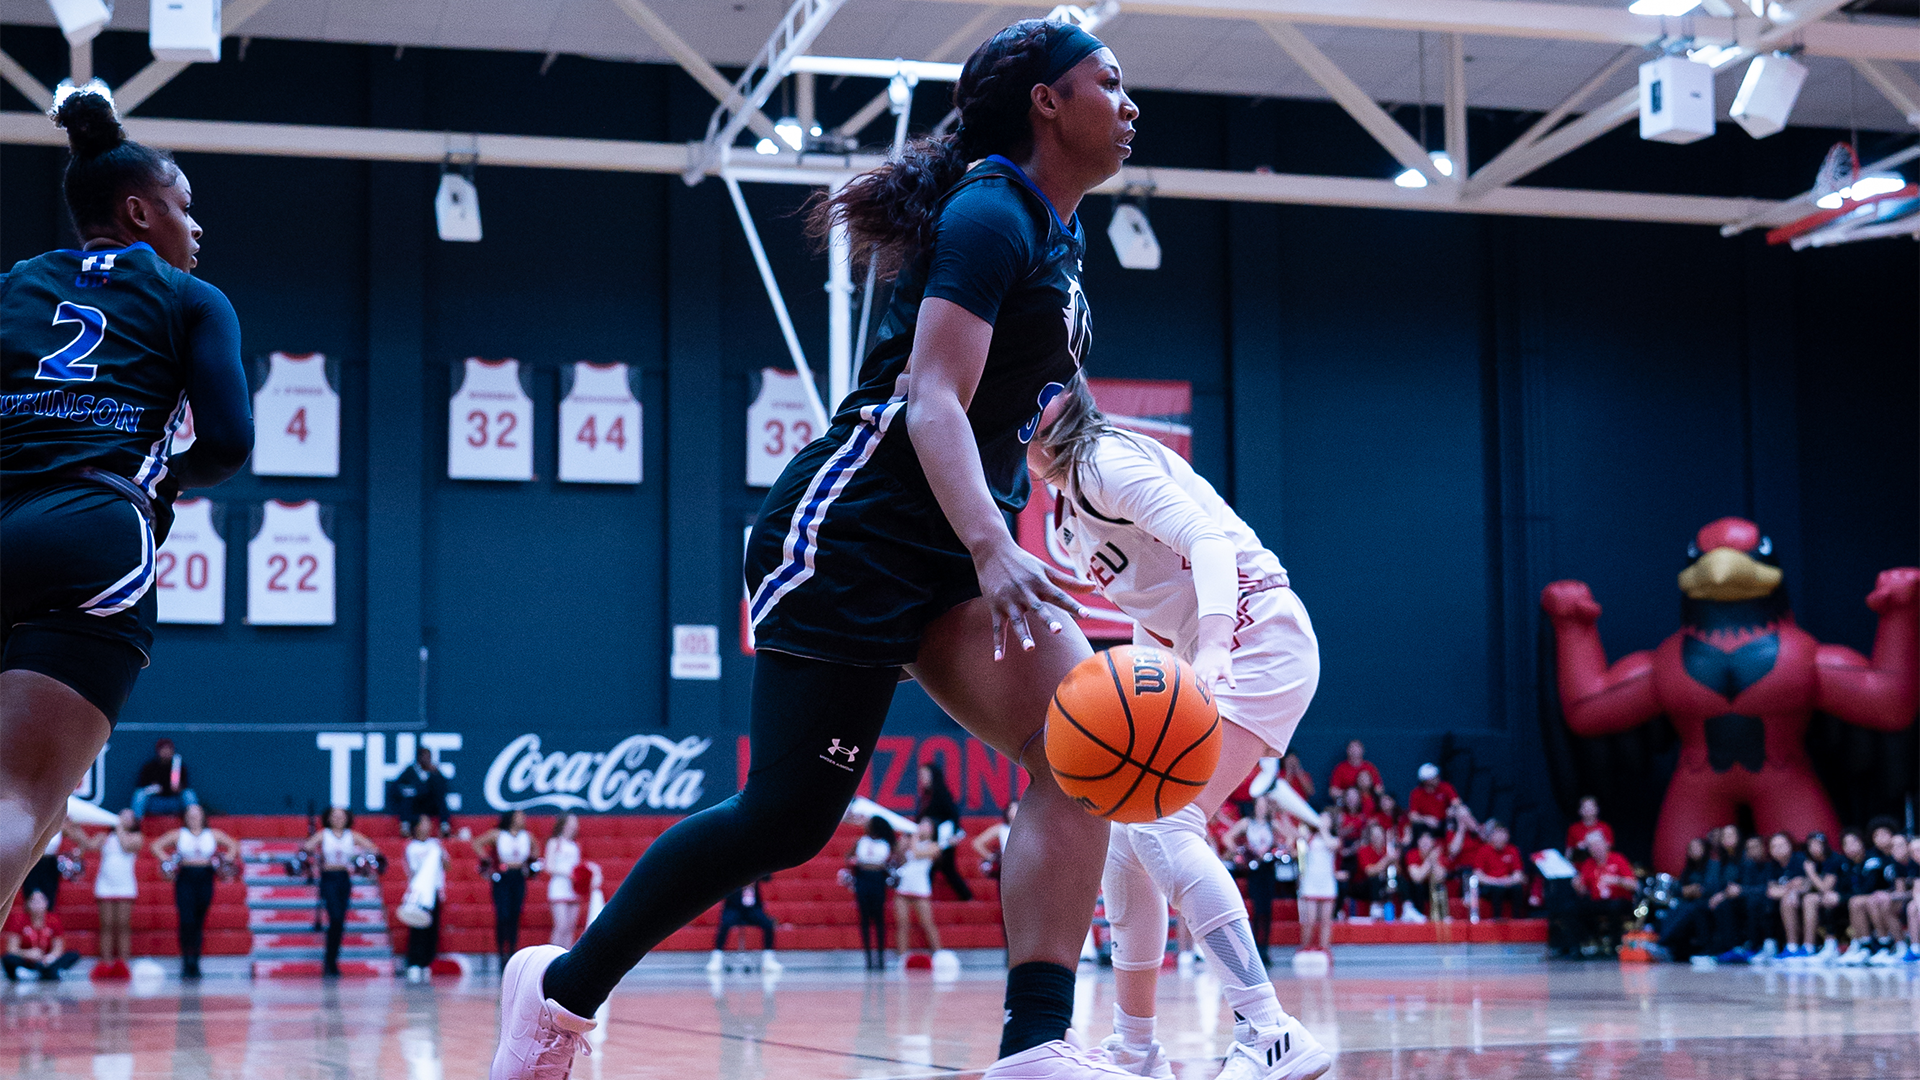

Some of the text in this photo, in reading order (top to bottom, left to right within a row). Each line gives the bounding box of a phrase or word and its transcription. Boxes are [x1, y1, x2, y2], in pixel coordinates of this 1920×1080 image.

[34, 300, 108, 382] 2
[0, 389, 145, 433] OBINSON
[285, 406, 309, 444] 4
[467, 409, 518, 448] 32
[576, 415, 626, 451] 44
[156, 551, 209, 591] 20
[267, 554, 318, 592] 22
[483, 732, 713, 812] Coca-Cola
